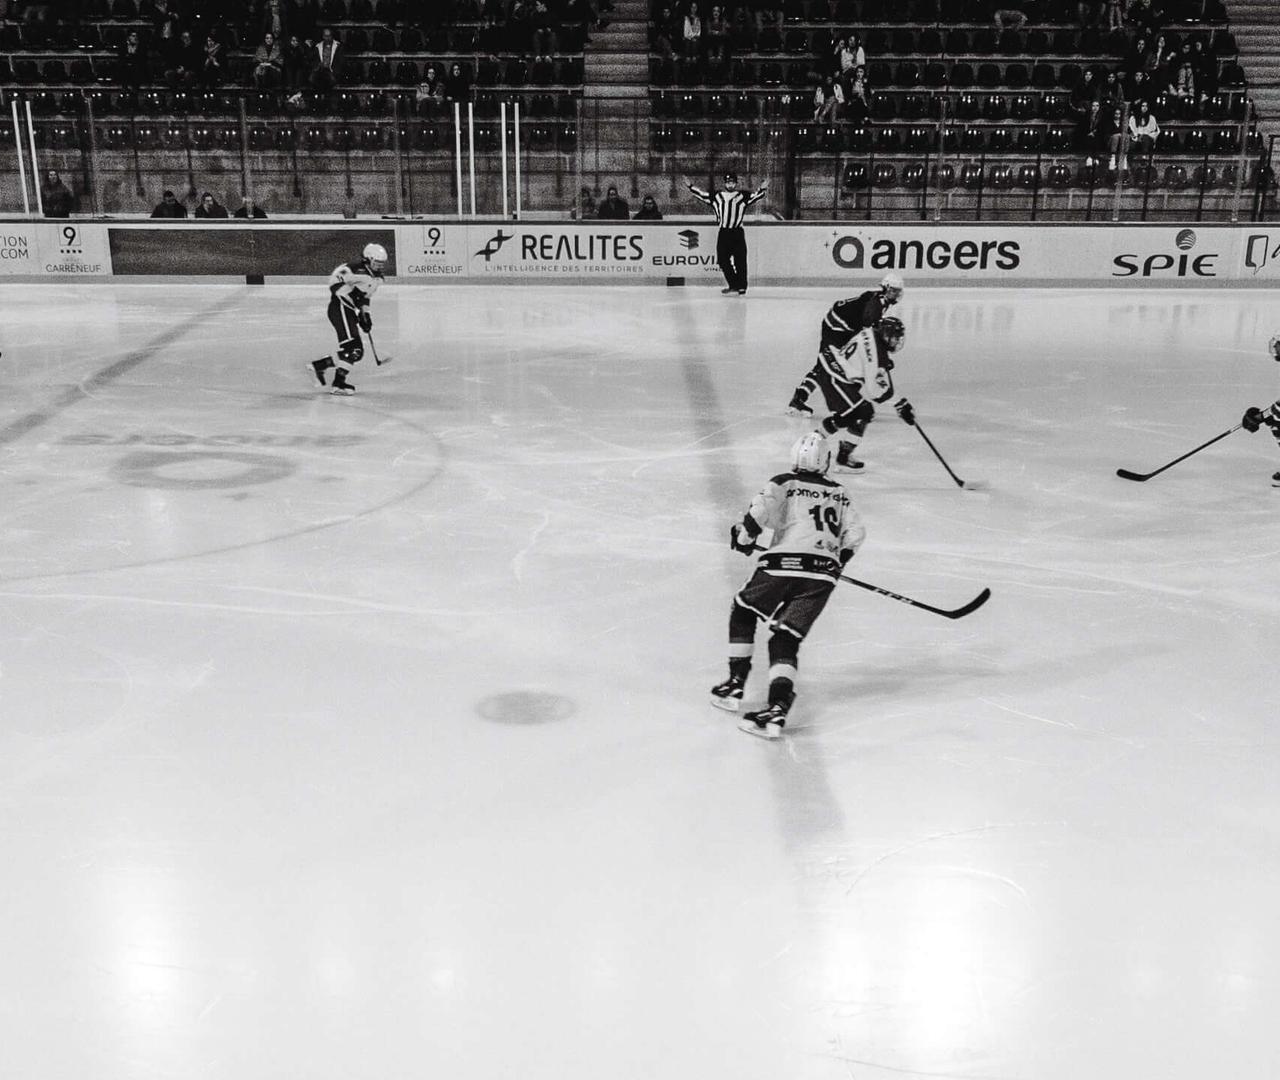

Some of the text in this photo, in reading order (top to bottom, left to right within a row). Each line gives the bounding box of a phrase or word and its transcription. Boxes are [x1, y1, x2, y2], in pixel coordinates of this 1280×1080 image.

[63, 226, 76, 246] 9
[428, 227, 441, 247] 9
[652, 255, 719, 266] EUROVI
[870, 238, 1021, 270] angers
[1112, 254, 1218, 277] SPIE
